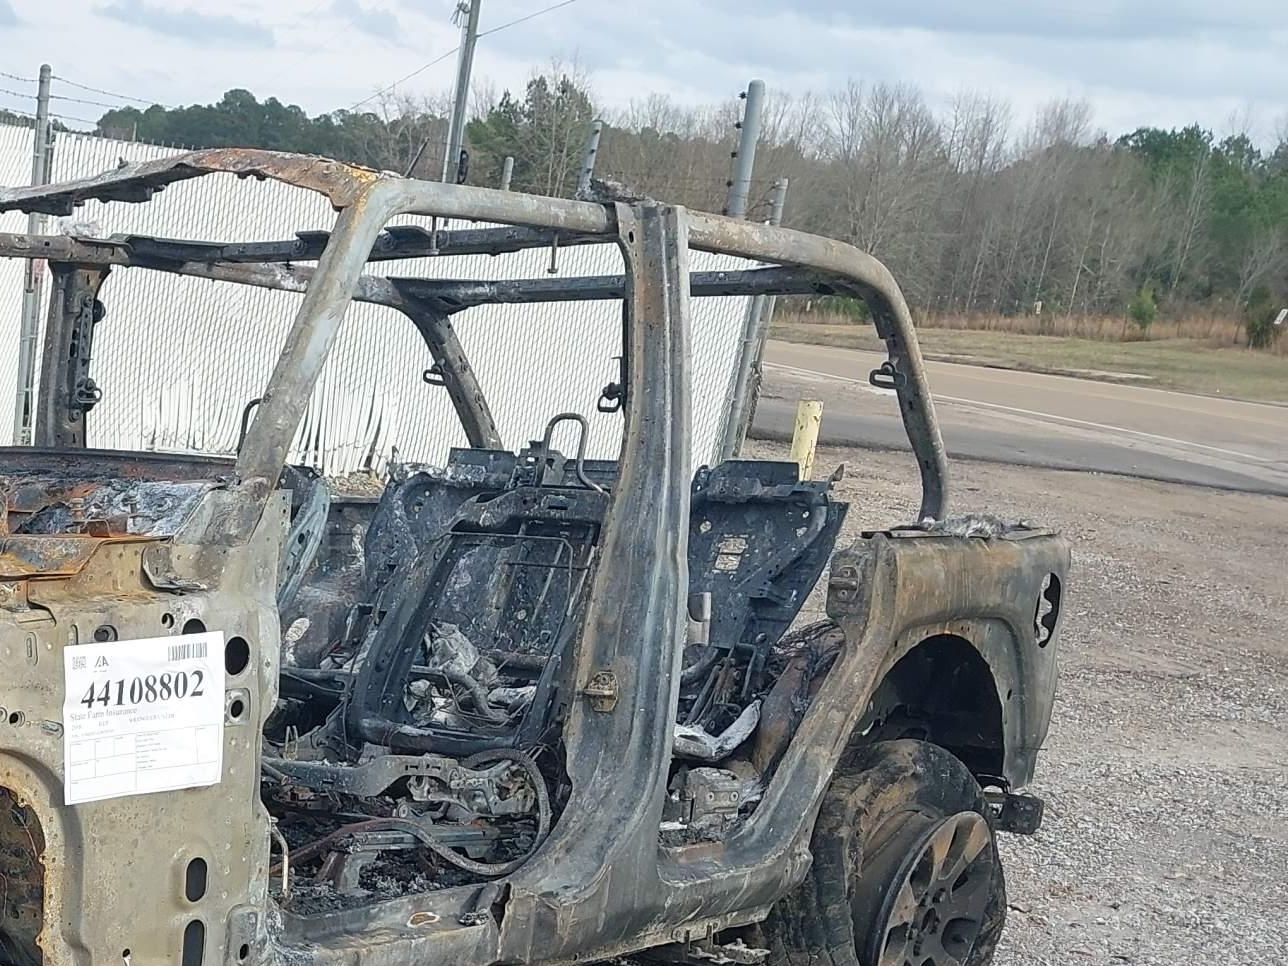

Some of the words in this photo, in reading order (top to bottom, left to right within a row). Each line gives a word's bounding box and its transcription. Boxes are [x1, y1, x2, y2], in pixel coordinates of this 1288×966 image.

[80, 670, 204, 709] 44108802
[87, 710, 104, 719] Farm
[105, 708, 138, 717] Insurance
